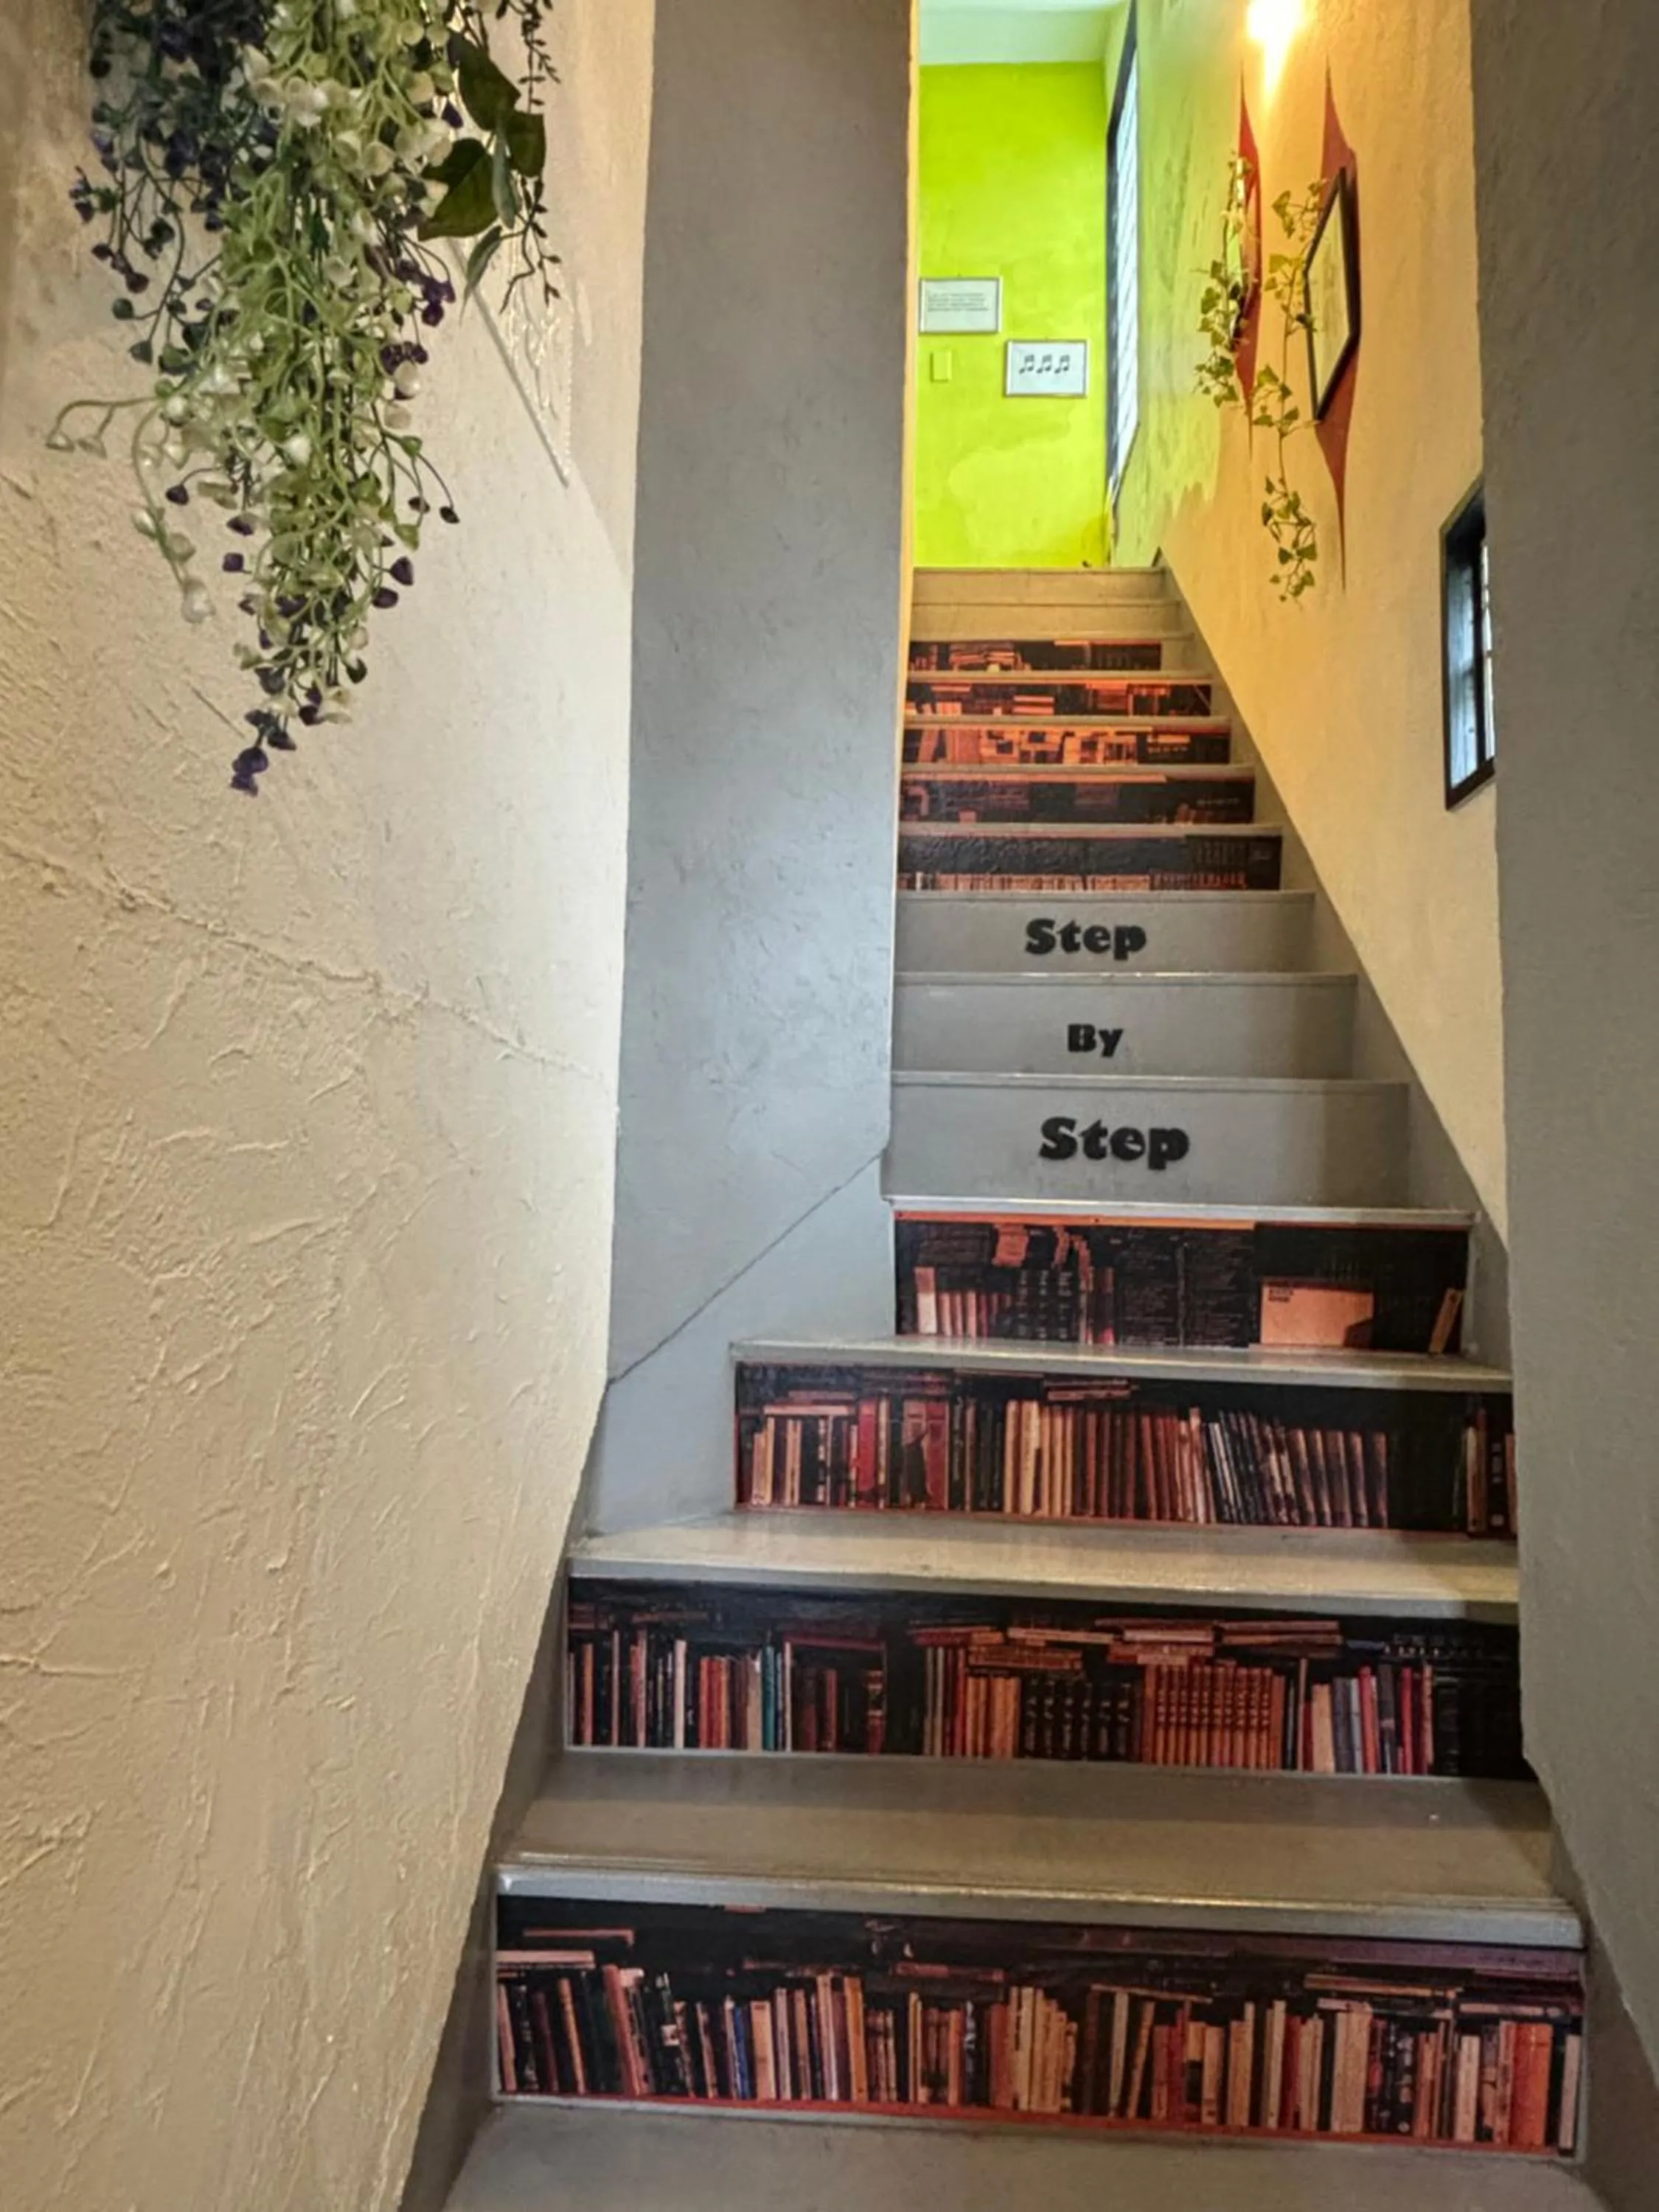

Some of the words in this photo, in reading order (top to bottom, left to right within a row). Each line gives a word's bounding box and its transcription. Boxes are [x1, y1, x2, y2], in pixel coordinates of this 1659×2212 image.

[1025, 919, 1147, 961] Step
[1067, 1023, 1123, 1058] By
[1039, 1117, 1190, 1171] Step
